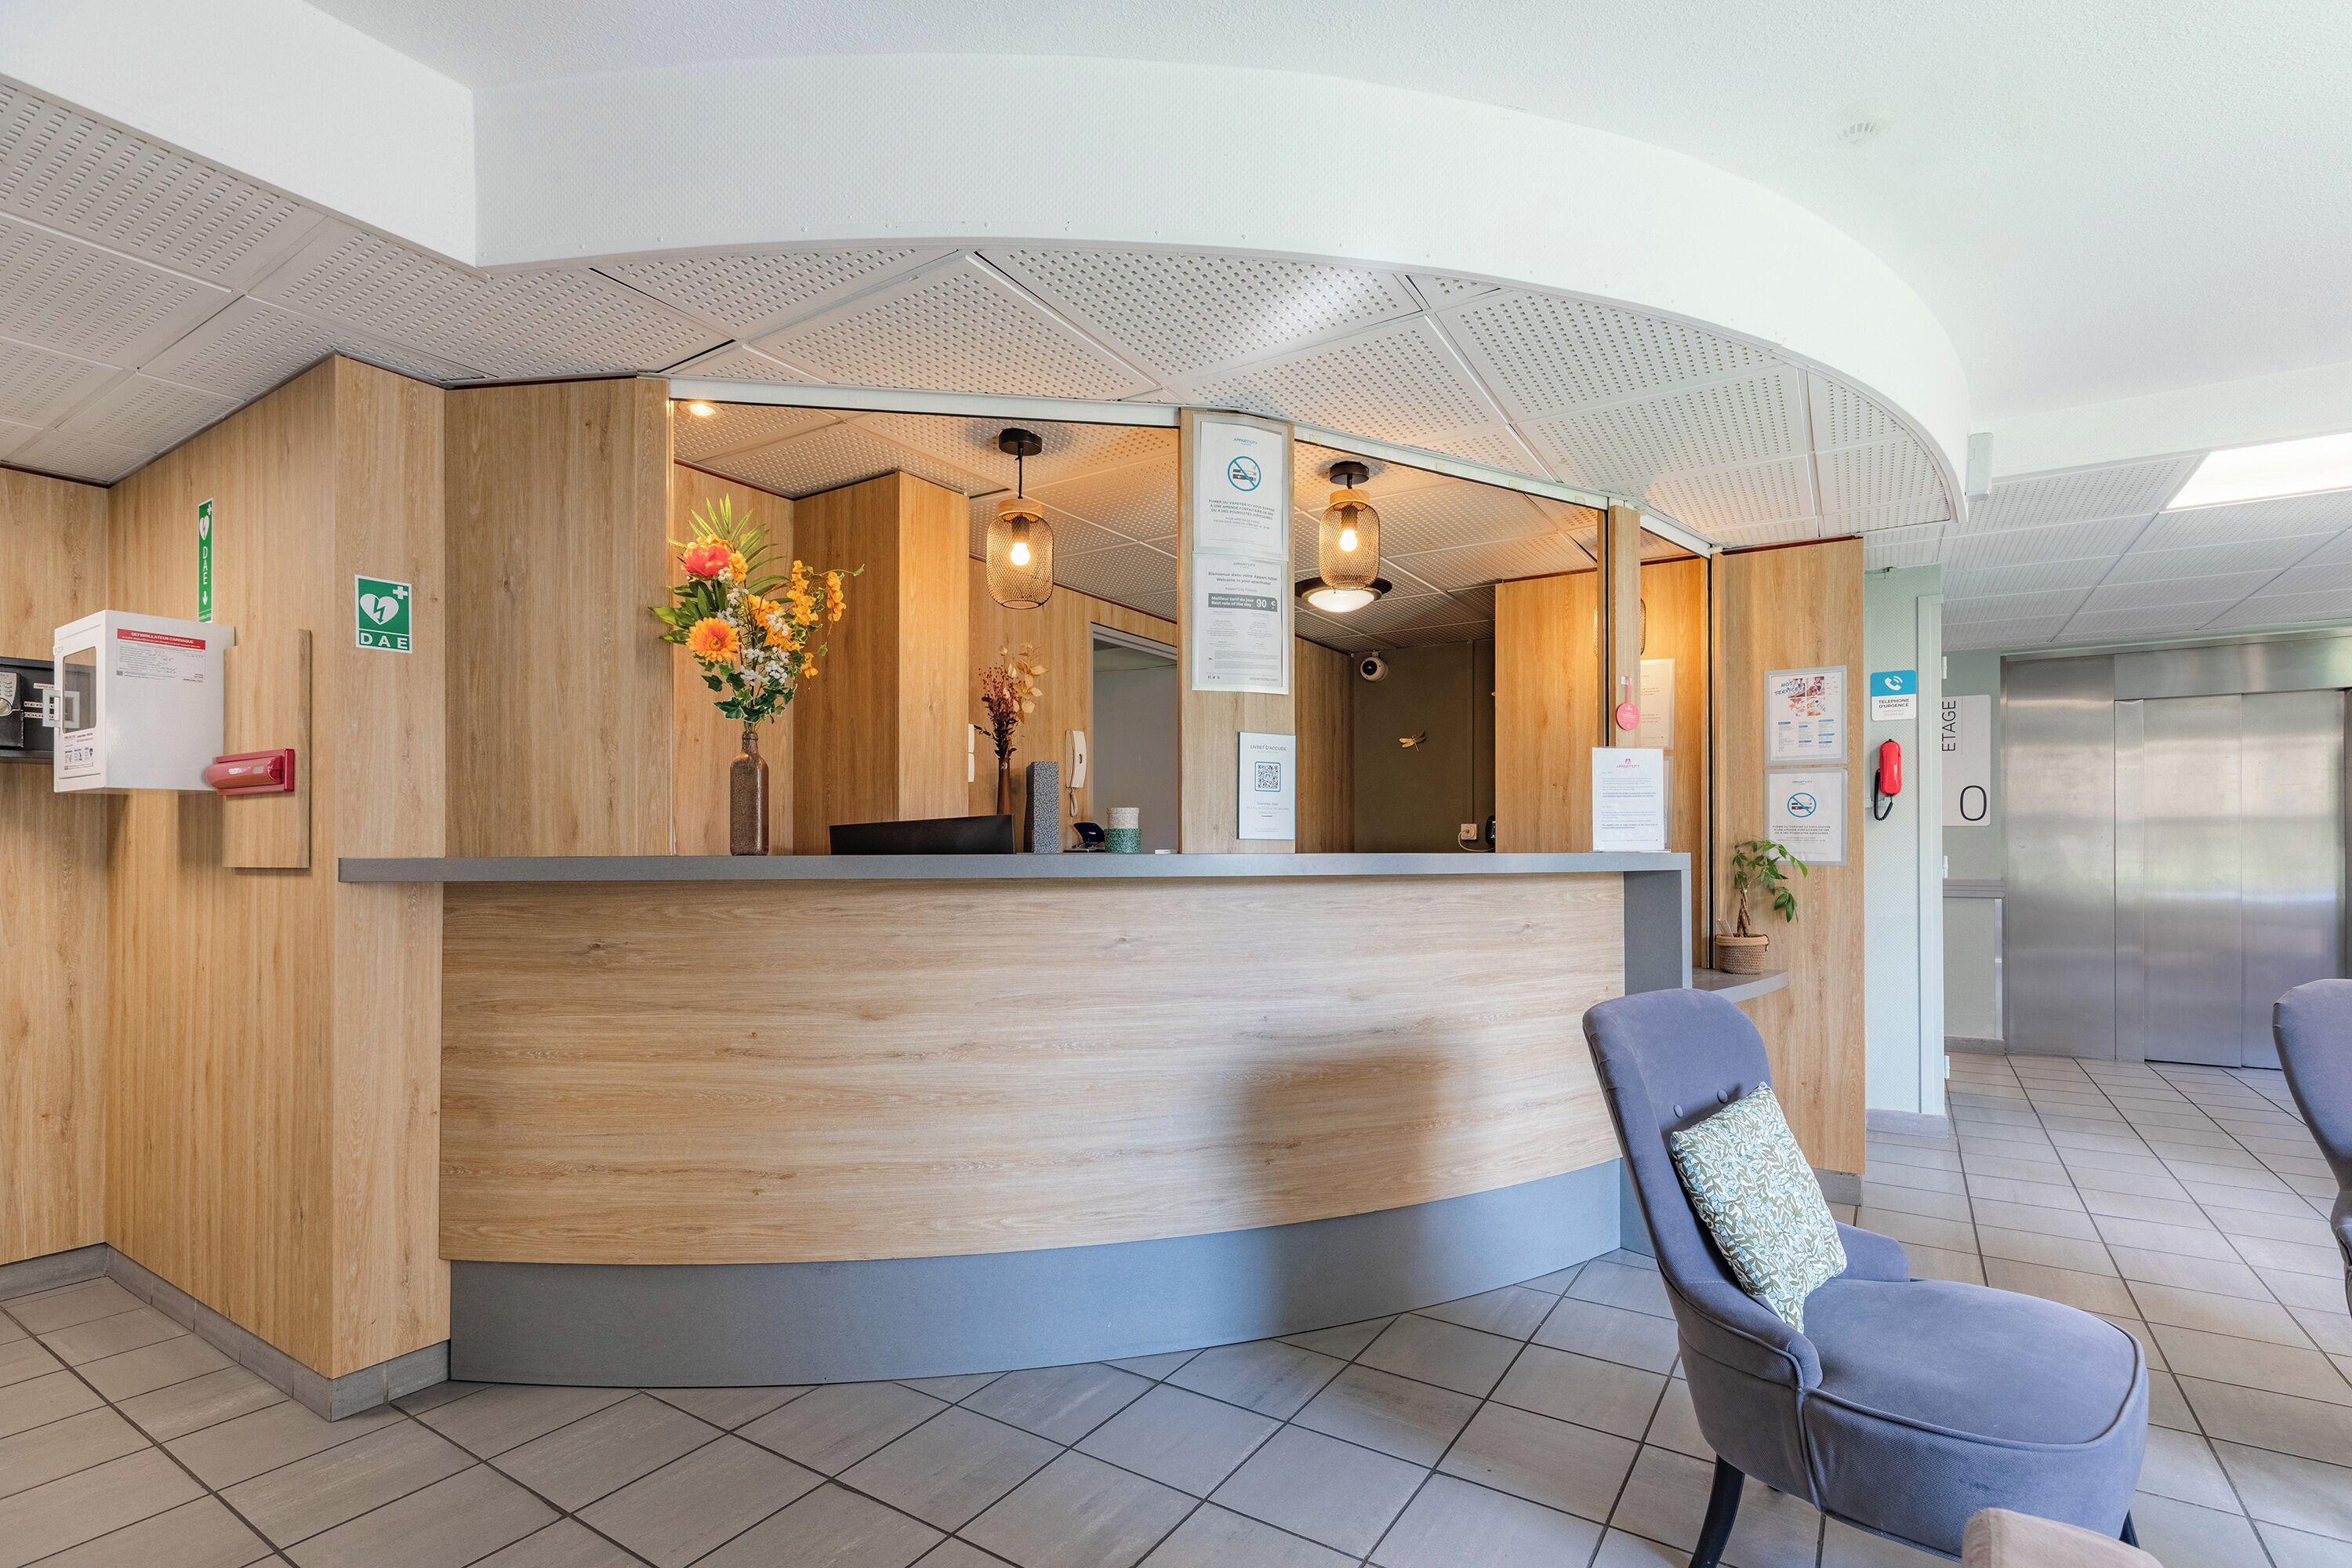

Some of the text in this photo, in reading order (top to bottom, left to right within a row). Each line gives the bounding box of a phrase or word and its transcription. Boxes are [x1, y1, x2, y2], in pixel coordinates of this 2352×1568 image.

[1256, 599, 1267, 608] 90
[360, 632, 408, 649] DAE
[1775, 686, 1802, 696] SERVICES
[1942, 701, 1956, 751] ETAGE
